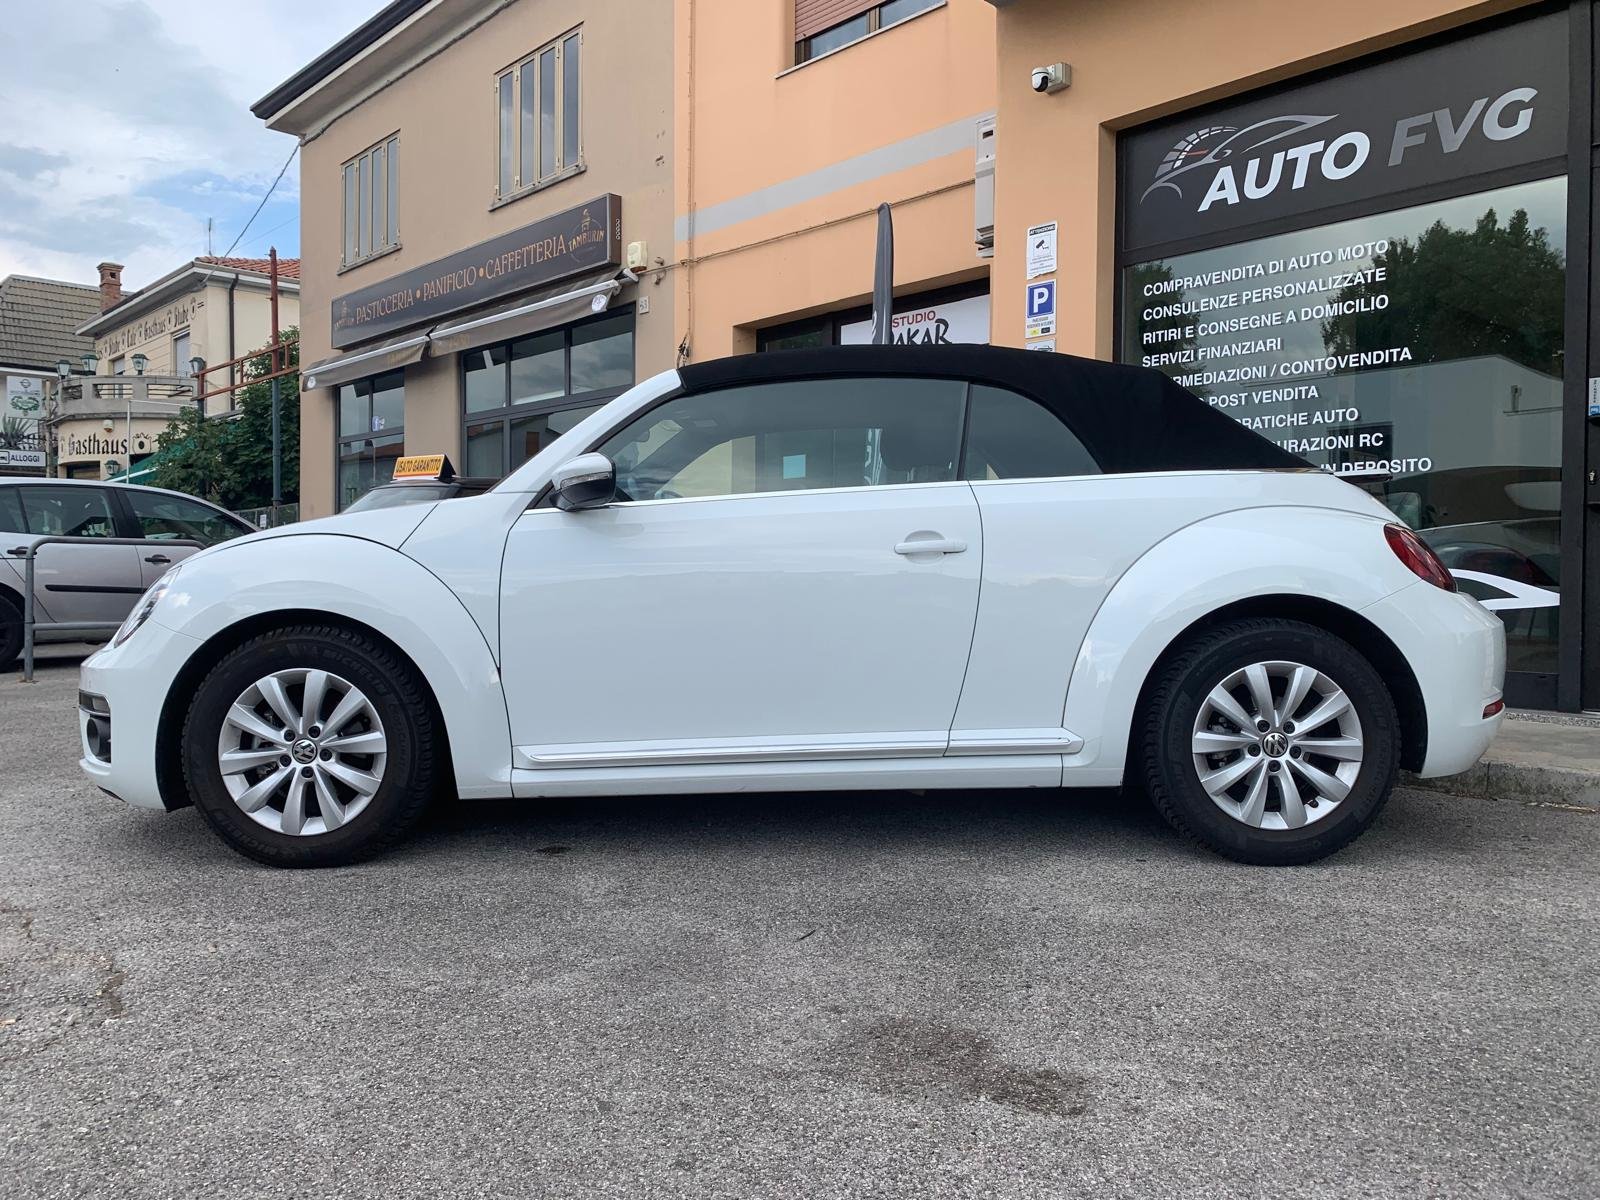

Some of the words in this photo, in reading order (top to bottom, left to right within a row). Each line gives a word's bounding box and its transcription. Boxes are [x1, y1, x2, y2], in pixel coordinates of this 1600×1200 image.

[1197, 131, 1370, 212] AUTO
[1388, 87, 1538, 168] FVG
[568, 229, 605, 252] TAMBURIN
[356, 288, 416, 324] PASTICCERIA
[423, 266, 477, 301] PANIFICIO
[485, 234, 568, 280] CAFFETTERIA
[1143, 264, 1265, 297] COMPRAVENDITA
[1269, 260, 1286, 274] DI
[1288, 251, 1334, 272] AUTO
[1338, 239, 1389, 262] MOTO
[1033, 287, 1049, 313] P
[1143, 295, 1238, 321] CONSULENZE
[1242, 267, 1387, 304] PERSONALIZZATE
[892, 310, 936, 328] STUDIO
[892, 318, 952, 345] AKAR
[1143, 326, 1182, 345] RITIRI
[1185, 324, 1194, 338] E
[1198, 313, 1282, 337] CONSEGNE
[1286, 311, 1297, 325] A
[1301, 294, 1389, 321] DOMICILIO
[1142, 349, 1194, 368] SERVIZI
[1198, 337, 1281, 361] FINANZIARI
[1170, 365, 1267, 388] RMEDIAZIONI
[1281, 347, 1413, 378] CONTOVENDITA
[1209, 393, 1248, 408] POST
[1252, 385, 1319, 404] VENDITA
[1234, 412, 1308, 430] RATICHE
[1312, 407, 1359, 424] AUTO
[68, 432, 128, 456] Gasthaus
[1272, 435, 1354, 453] URAZIONI
[1359, 432, 1384, 447] RC
[11, 454, 40, 463] ALLOGGI
[1321, 463, 1336, 472] IN
[1341, 457, 1432, 473] DEPOSITO
